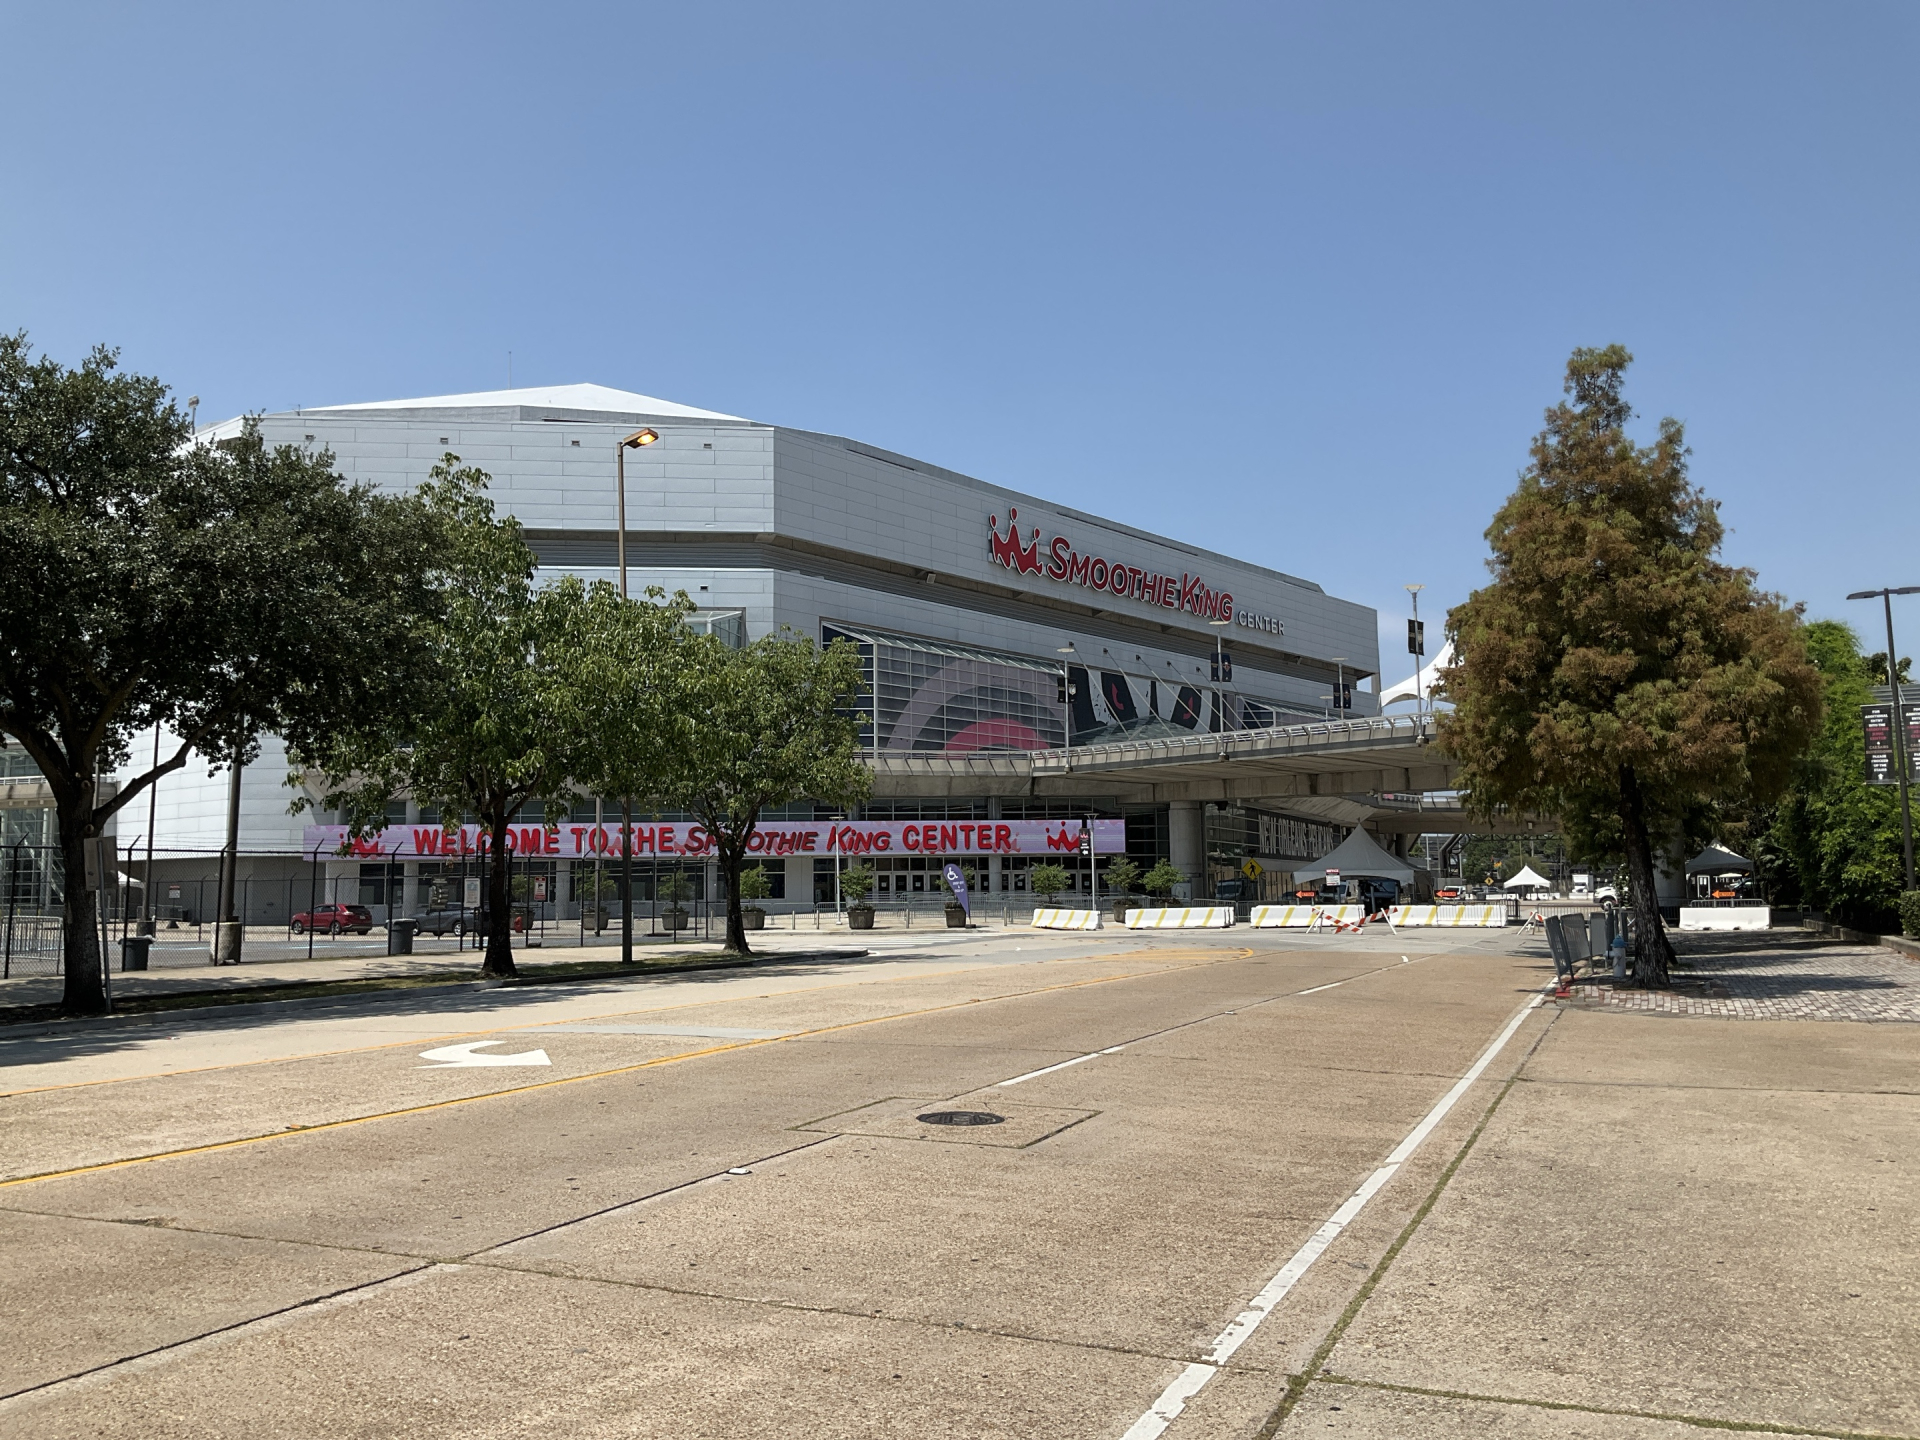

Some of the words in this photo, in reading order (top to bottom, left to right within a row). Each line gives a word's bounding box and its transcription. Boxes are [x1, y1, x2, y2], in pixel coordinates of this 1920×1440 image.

[1046, 536, 1177, 608] SMOOTHIE
[1238, 610, 1285, 636] CENTER
[413, 827, 560, 854] WELCOME
[570, 827, 608, 854] TO
[902, 824, 1012, 851] CENTER
[1258, 814, 1277, 855] NEW
[1278, 817, 1307, 858] ORLEANS
